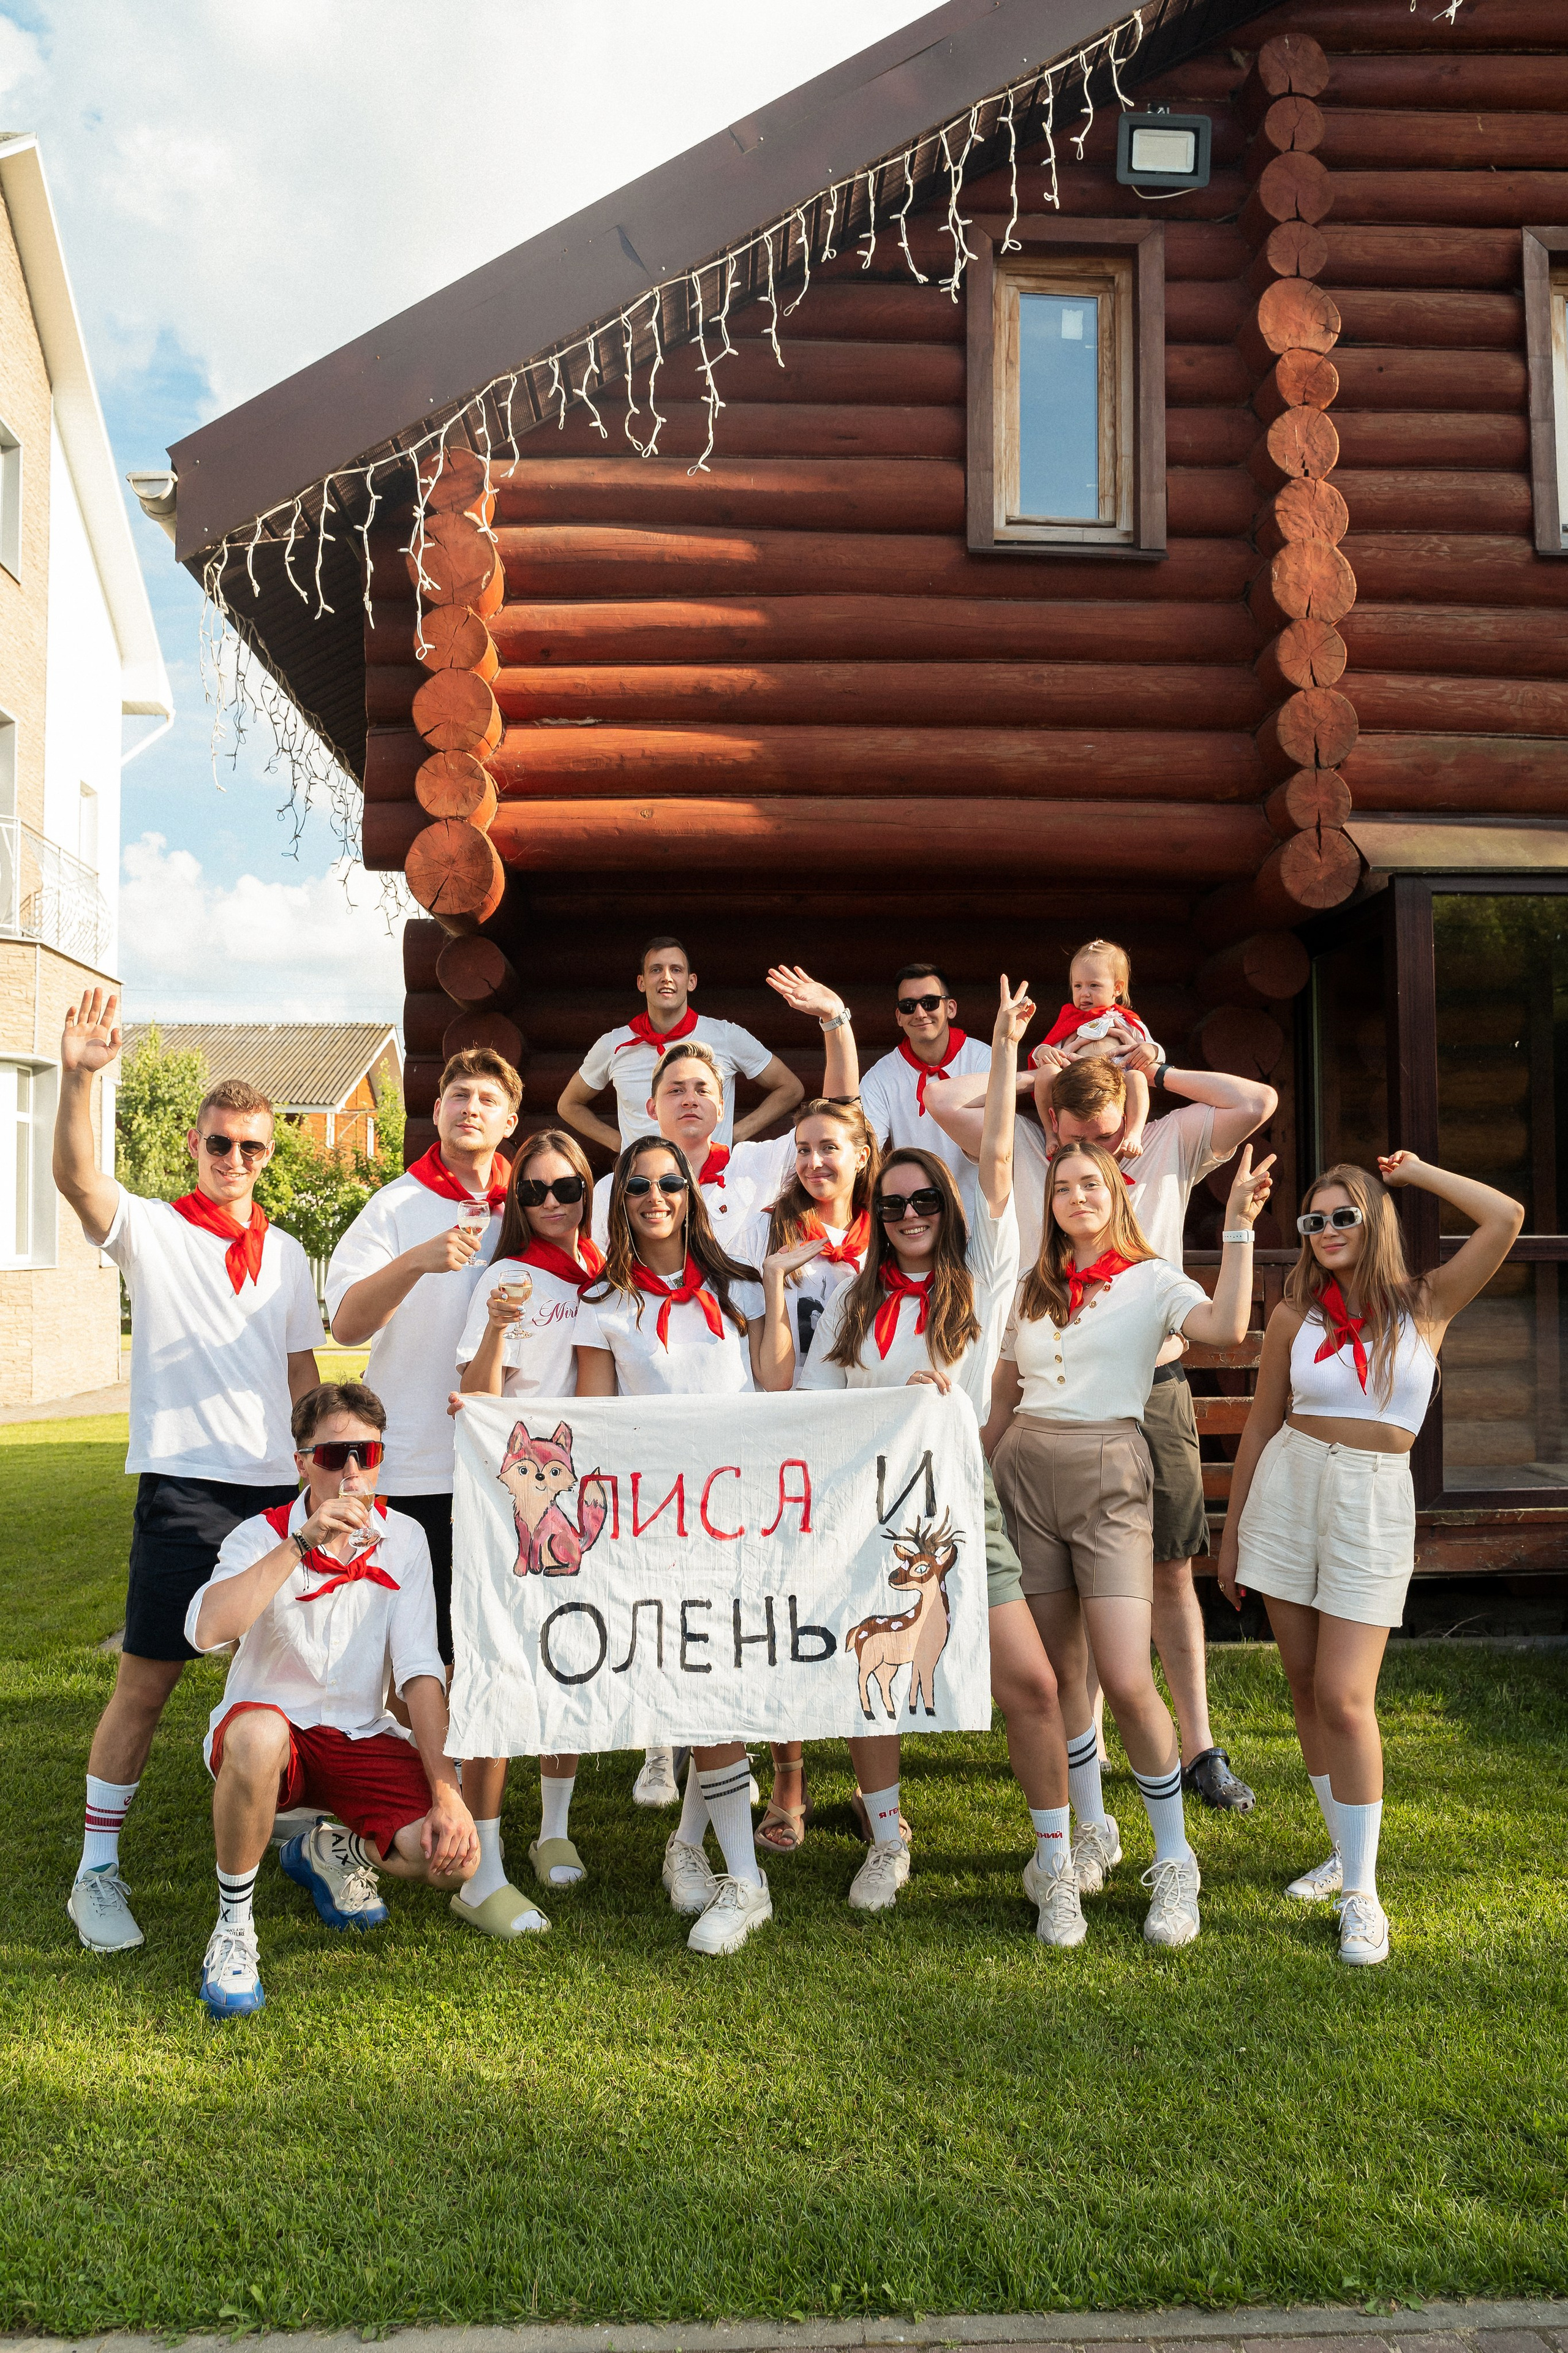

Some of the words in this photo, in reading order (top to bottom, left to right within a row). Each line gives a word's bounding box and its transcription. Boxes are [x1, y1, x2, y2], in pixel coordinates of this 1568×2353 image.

[571, 1458, 813, 1541] ЛИСА
[876, 1450, 937, 1524] И
[540, 1595, 837, 1685] ОЛЕНЬ
[889, 1807, 899, 1816] ГЕ
